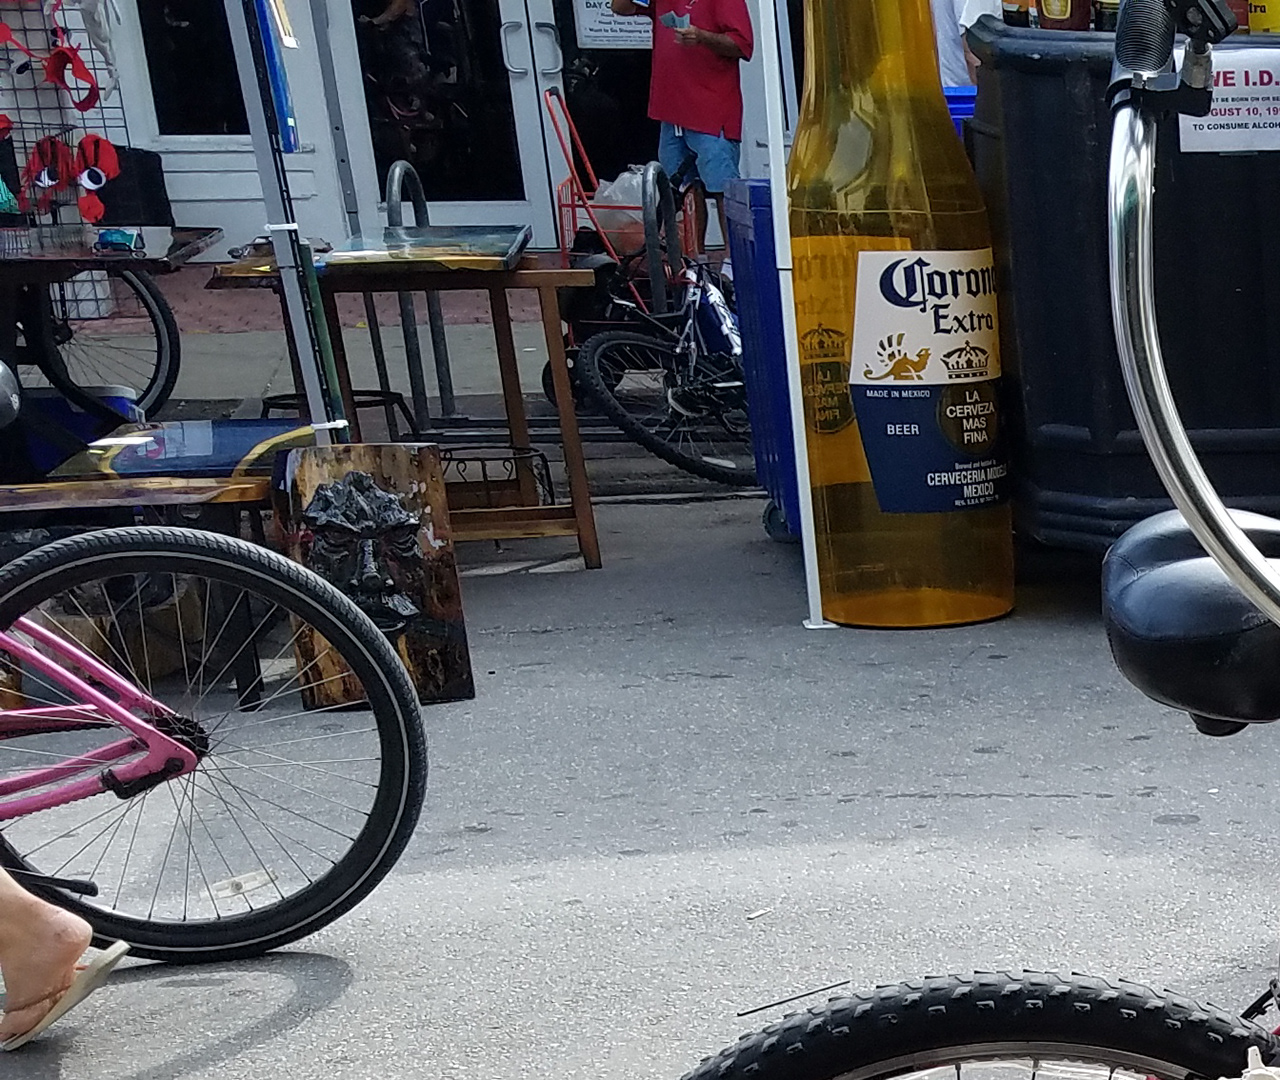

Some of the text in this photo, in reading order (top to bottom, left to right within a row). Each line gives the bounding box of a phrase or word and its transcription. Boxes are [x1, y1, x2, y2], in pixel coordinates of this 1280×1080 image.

[585, 1, 603, 9] DAY
[1244, 70, 1280, 87] I.D.
[1210, 107, 1242, 117] GUST
[1245, 107, 1262, 117] 10,
[1192, 123, 1205, 131] TO
[1207, 122, 1250, 131] CONSUME
[930, 303, 994, 335] Extra
[866, 389, 930, 398] MADE IN MEXICO
[965, 390, 980, 402] LA
[946, 402, 995, 418] CERVEZA
[887, 424, 920, 436] BEER
[963, 417, 987, 430] MAS
[964, 431, 988, 444] FINA
[927, 469, 986, 486] CERVECERIA
[964, 482, 994, 498] MEXICO
